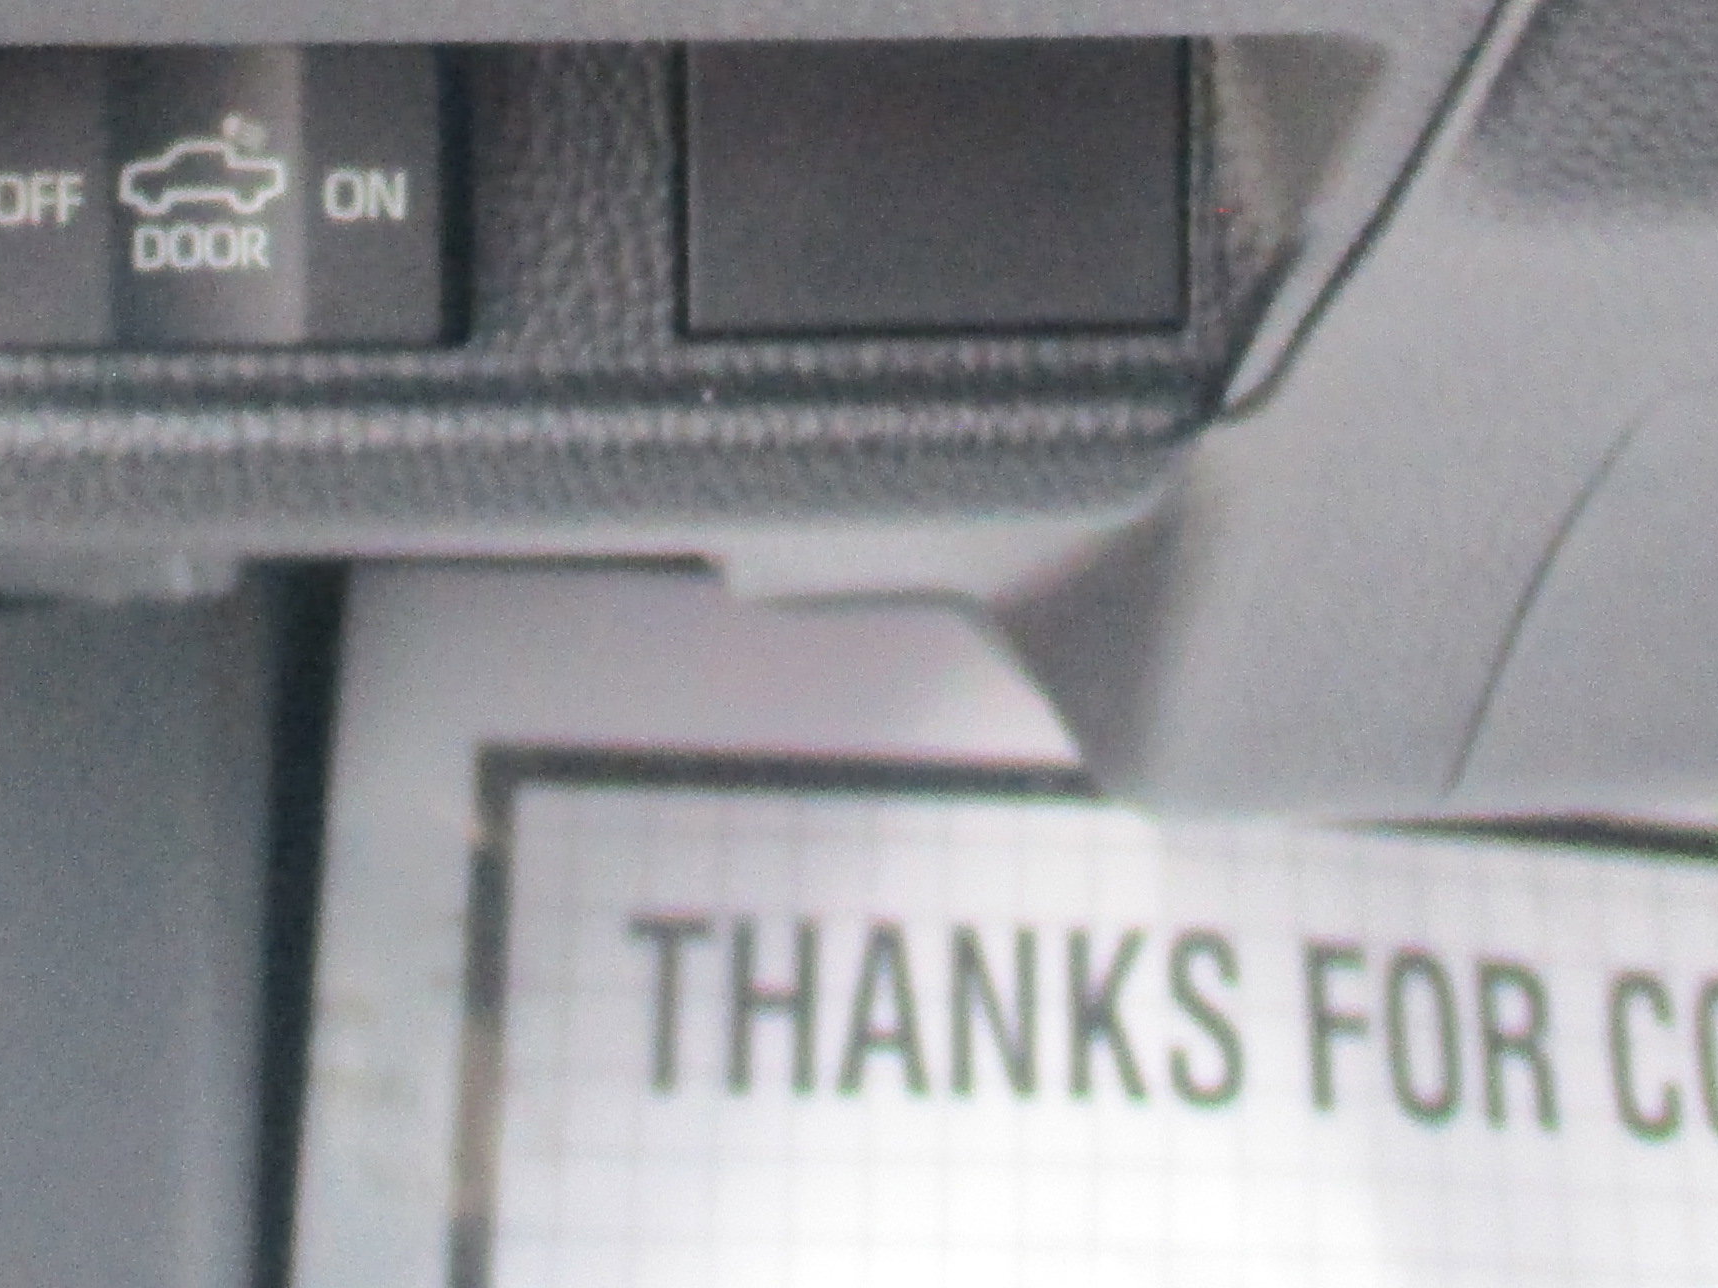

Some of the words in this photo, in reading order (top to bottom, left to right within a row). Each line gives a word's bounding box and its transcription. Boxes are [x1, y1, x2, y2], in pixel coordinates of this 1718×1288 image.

[321, 168, 407, 220] ON
[134, 226, 270, 270] DOOR
[626, 913, 1246, 1106] THANKS
[1301, 935, 1559, 1130] FOR
